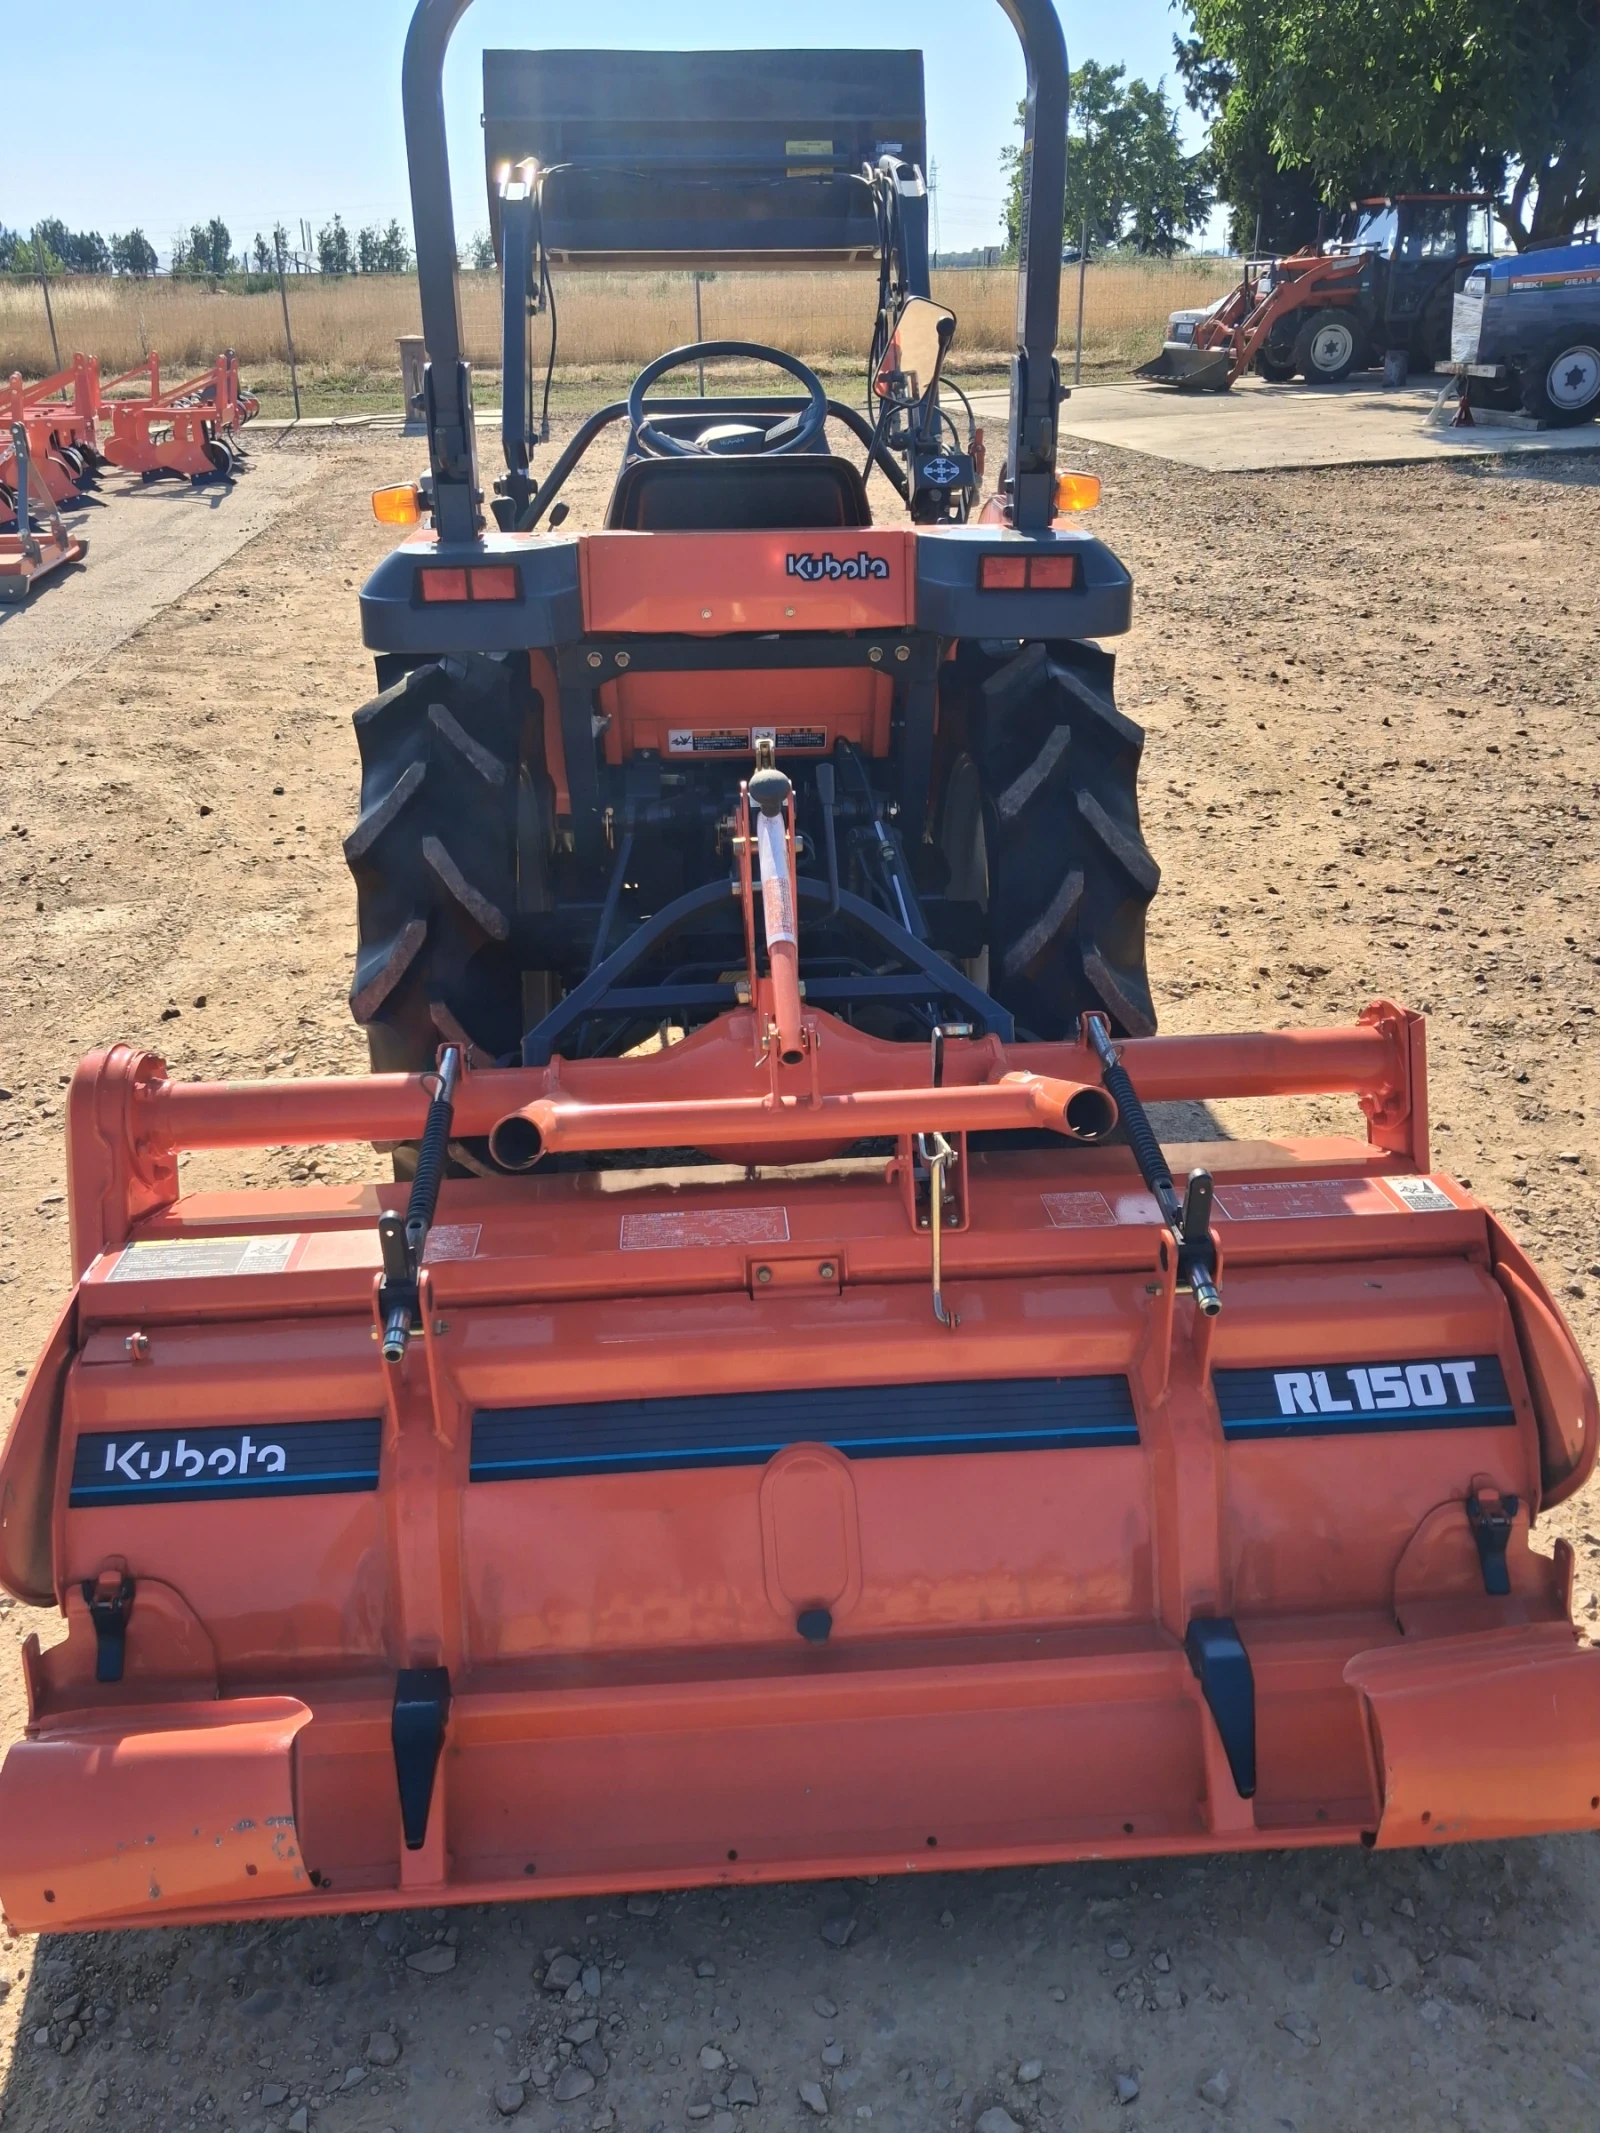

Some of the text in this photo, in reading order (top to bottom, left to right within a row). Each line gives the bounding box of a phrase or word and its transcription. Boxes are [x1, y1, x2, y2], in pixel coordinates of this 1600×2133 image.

[1513, 281, 1544, 290] ISEKI
[787, 552, 888, 580] Kubota
[1274, 1361, 1476, 1414] RL150T
[105, 1436, 286, 1480] Kubota
